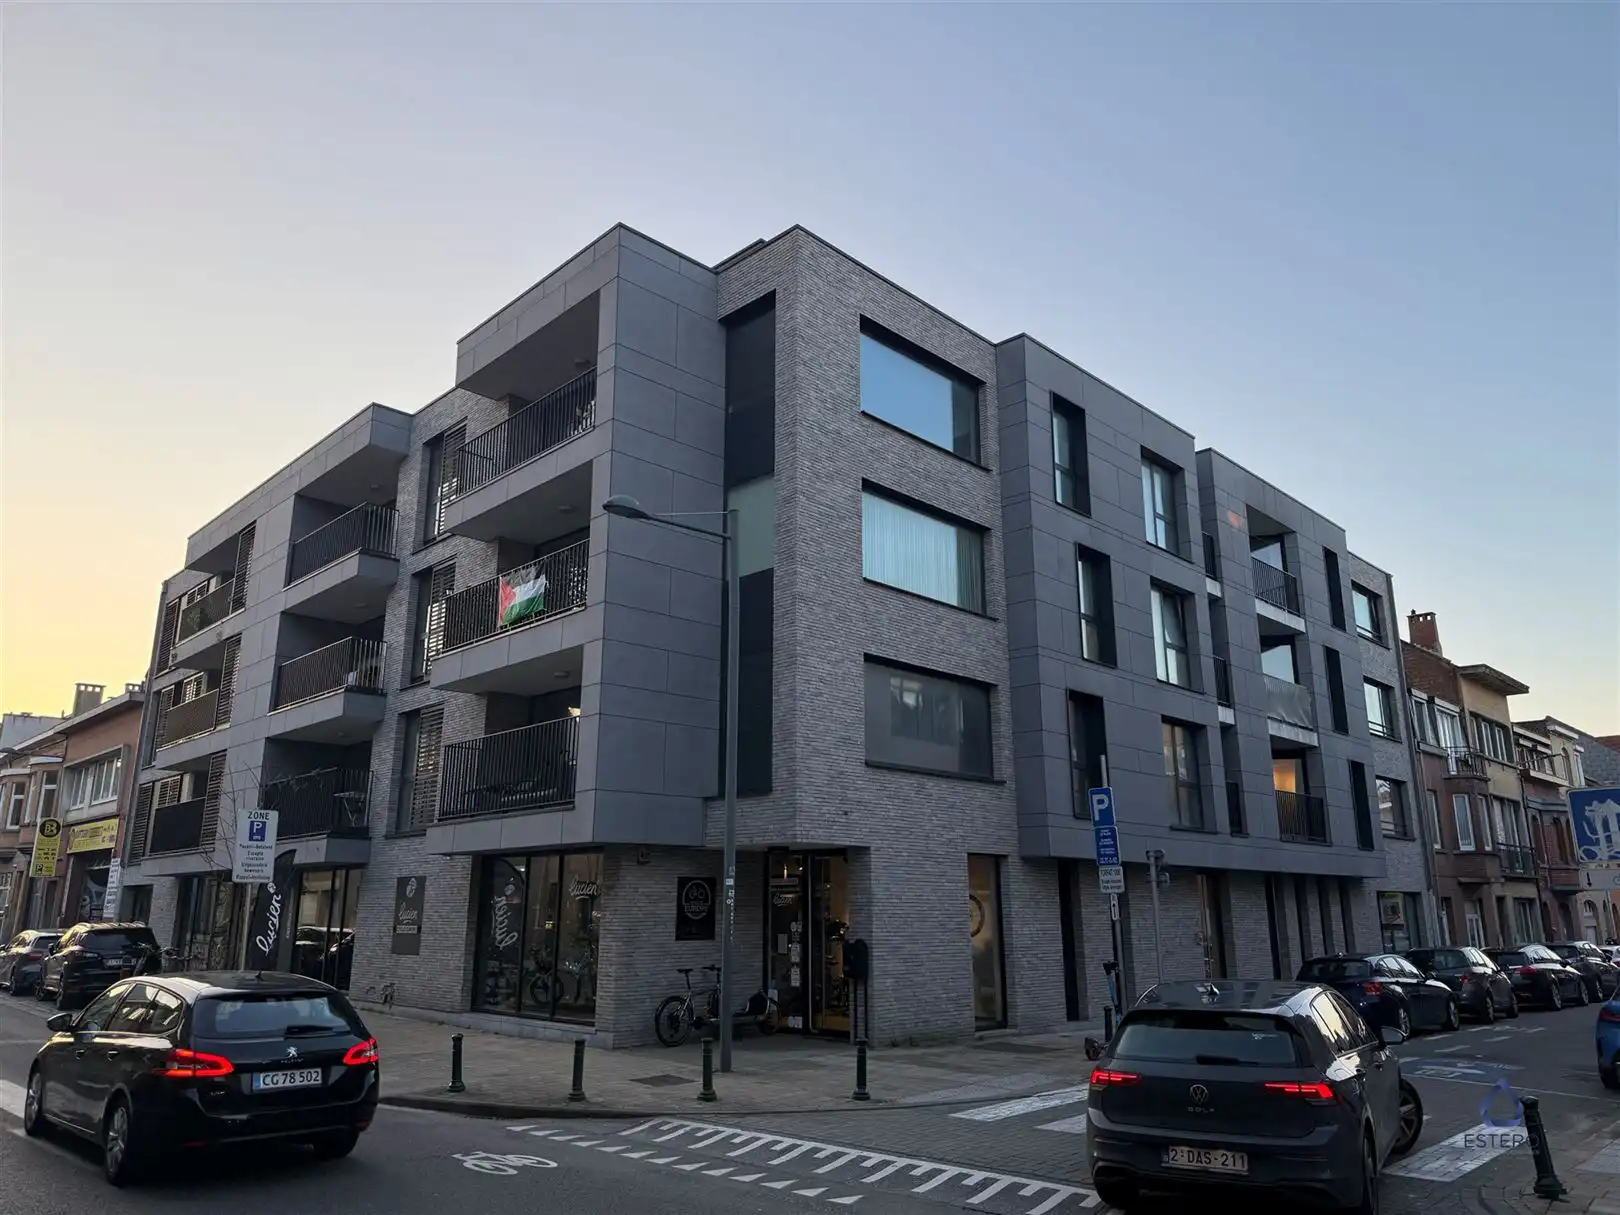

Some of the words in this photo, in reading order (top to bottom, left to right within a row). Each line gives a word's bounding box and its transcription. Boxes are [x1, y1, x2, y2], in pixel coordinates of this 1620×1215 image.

[1092, 794, 1109, 821] P
[247, 811, 270, 820] ZONE
[253, 822, 262, 833] P
[263, 1073, 279, 1086] CG
[282, 1072, 296, 1084] 78
[299, 1070, 319, 1083] 502
